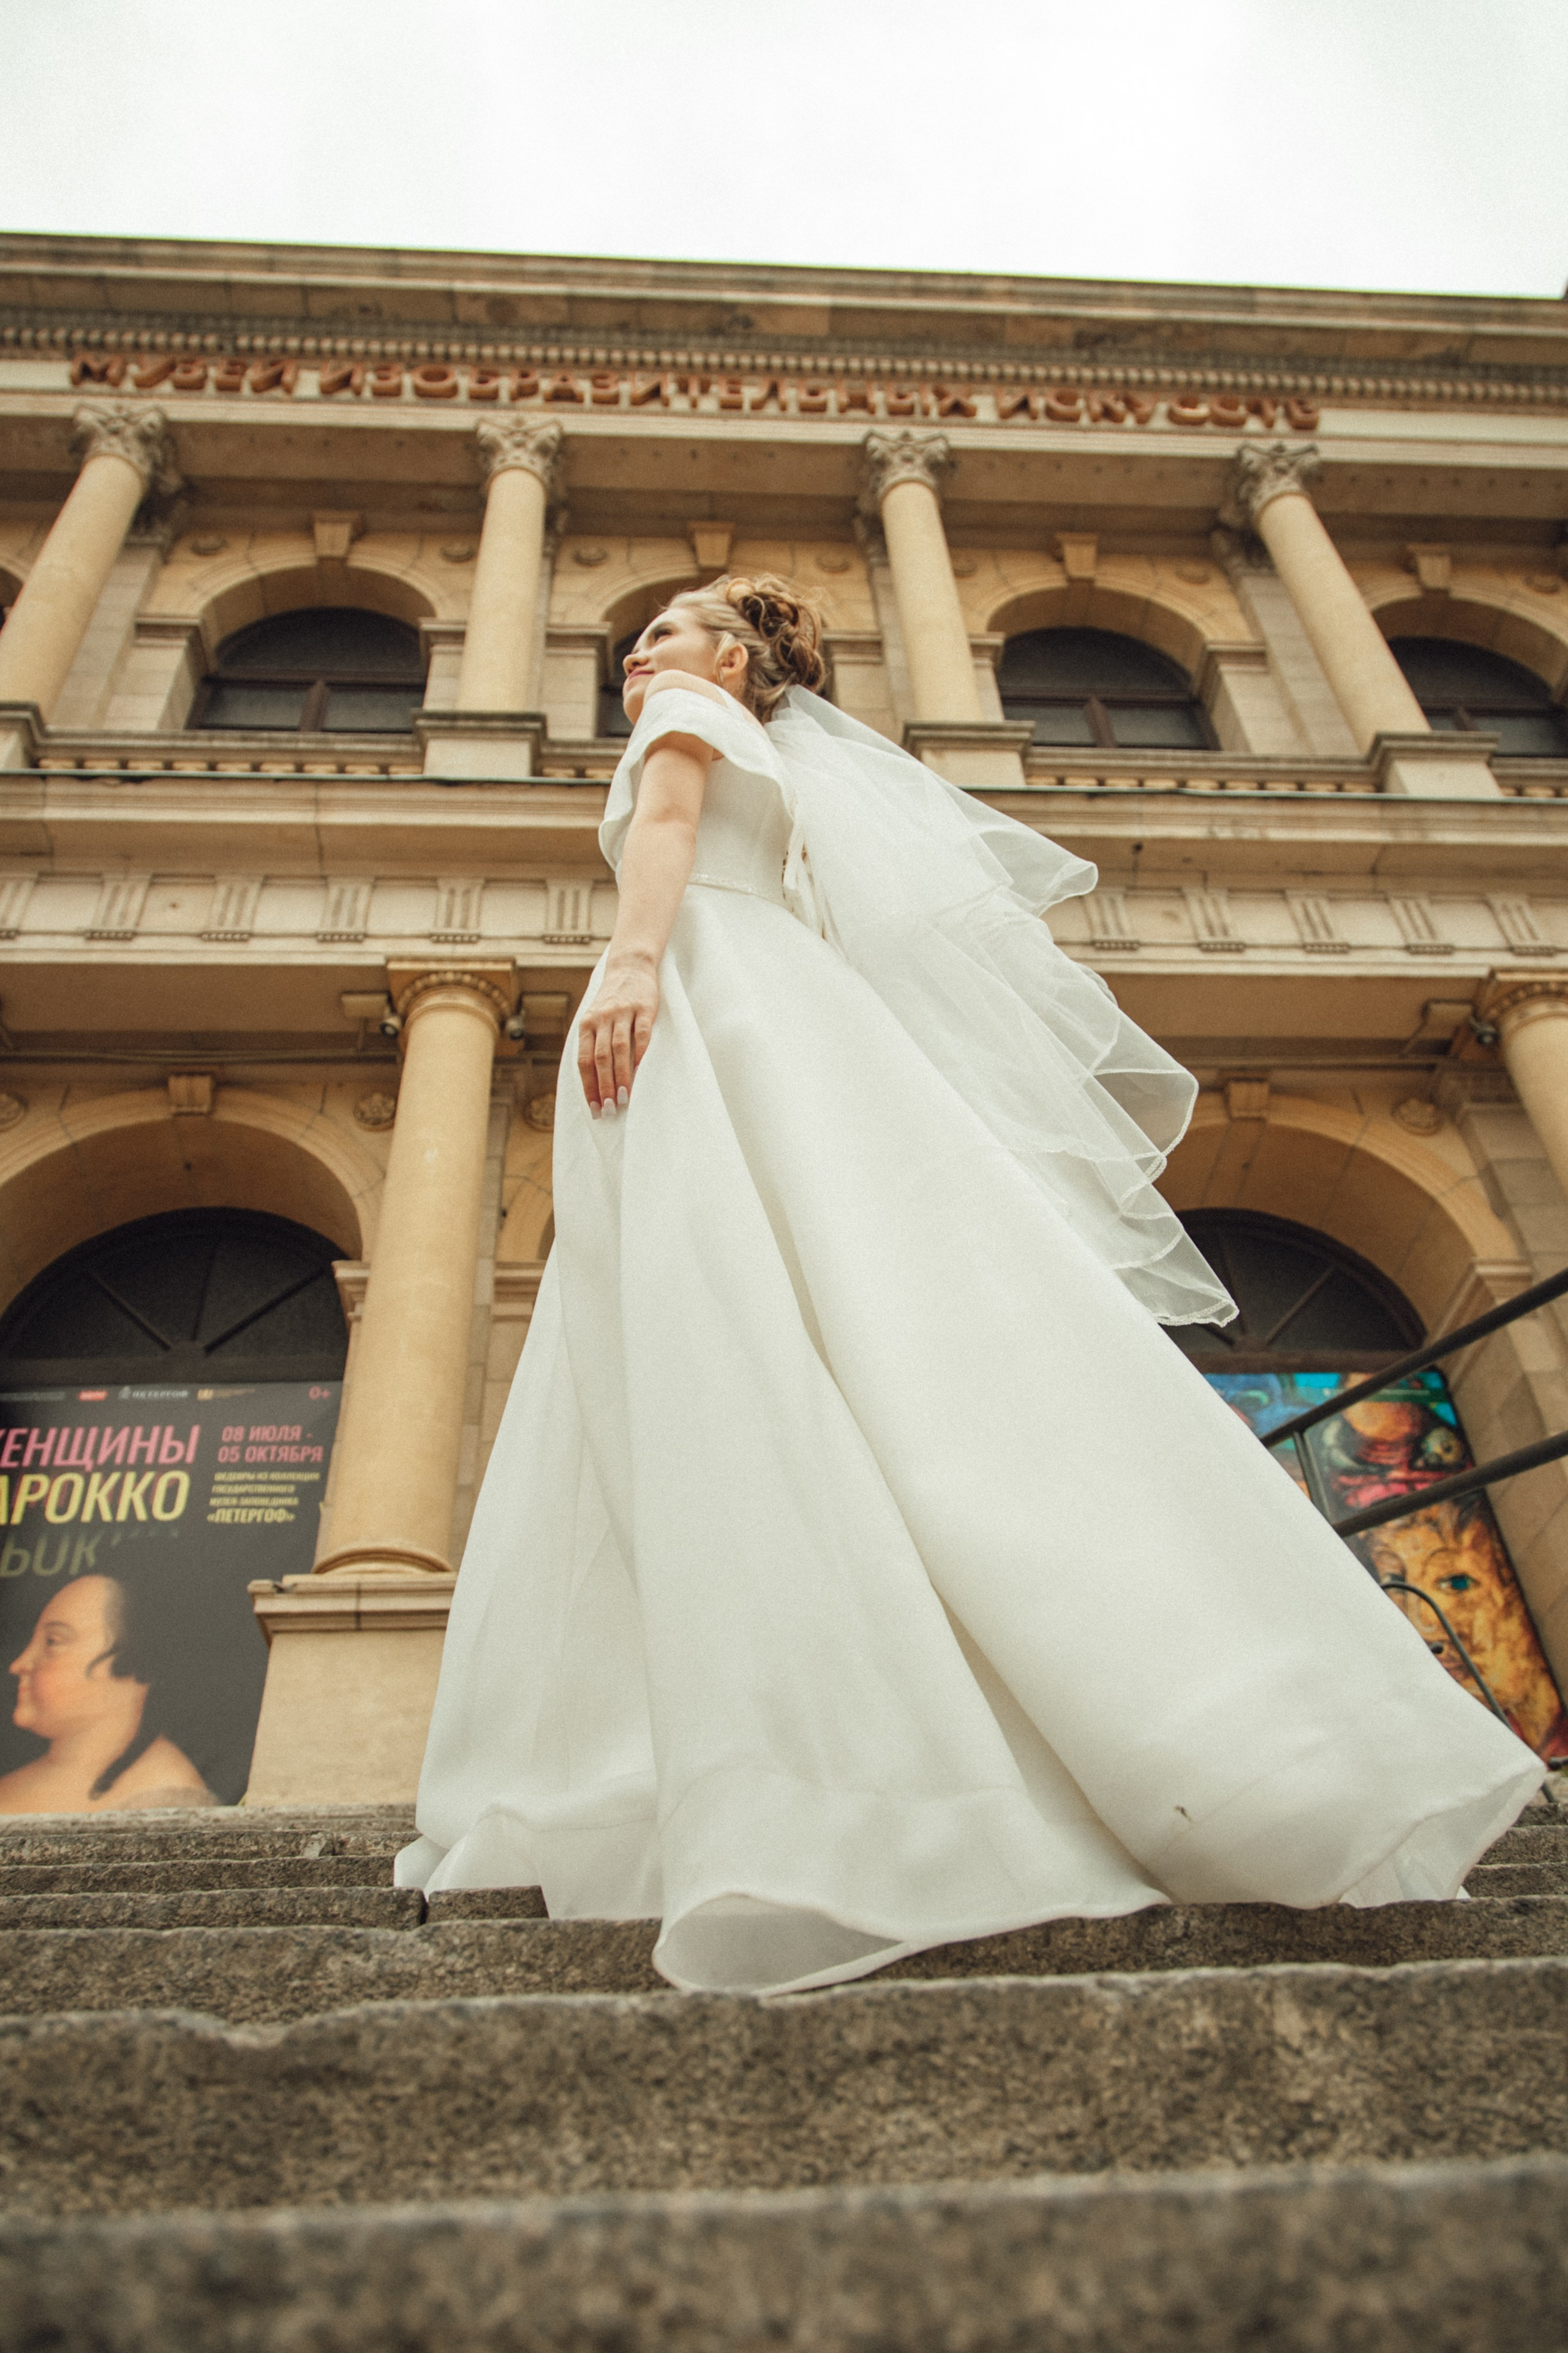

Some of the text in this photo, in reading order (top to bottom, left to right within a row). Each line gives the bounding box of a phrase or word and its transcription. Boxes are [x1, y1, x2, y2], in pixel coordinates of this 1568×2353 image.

[222, 1426, 244, 1442] 08
[249, 1426, 303, 1442] ИЮЛЯ
[0, 1426, 200, 1470] ЕНЩИНЫ
[217, 1446, 323, 1463] 05 ОКТЯБРЯ
